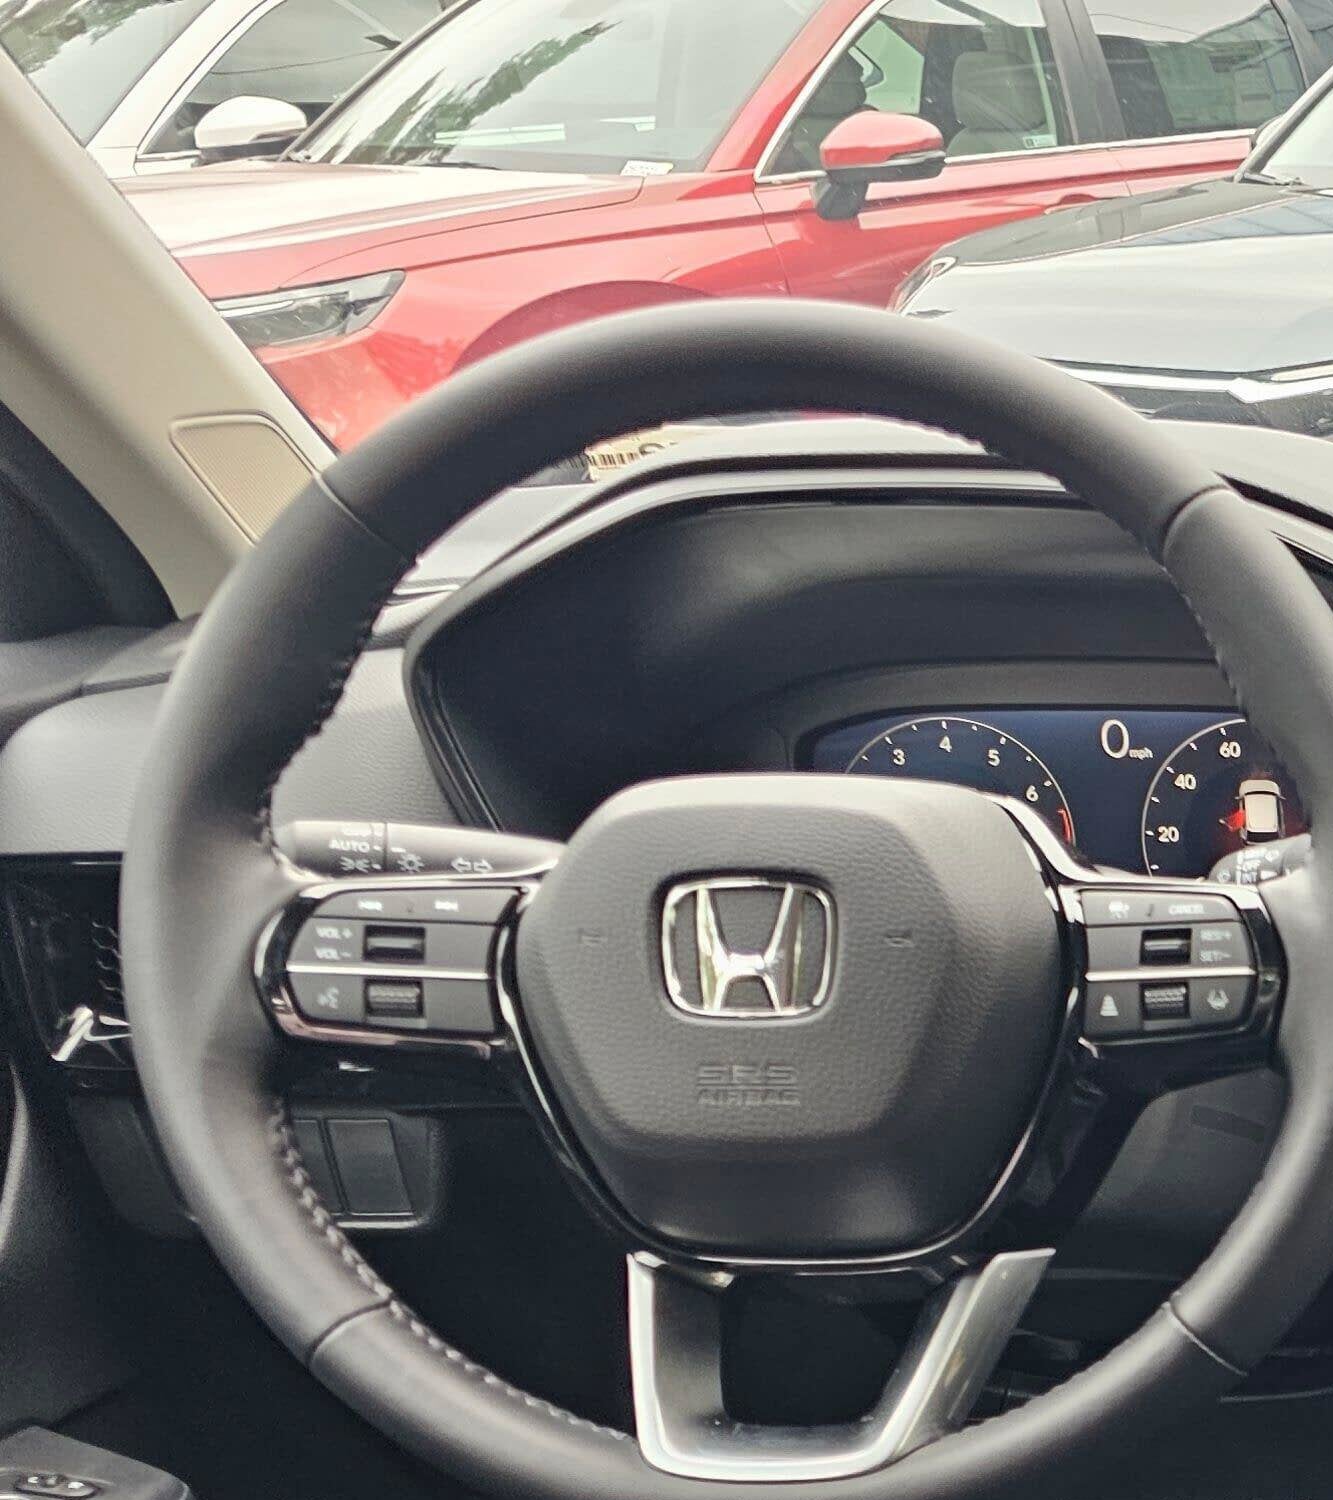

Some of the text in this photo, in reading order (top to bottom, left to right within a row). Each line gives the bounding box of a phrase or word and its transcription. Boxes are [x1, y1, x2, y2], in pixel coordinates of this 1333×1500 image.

[938, 735, 952, 753] 4
[1101, 719, 1130, 759] 0
[892, 748, 906, 766] 3
[987, 749, 1001, 767] 5
[1218, 741, 1242, 758] 60
[1174, 773, 1197, 790] 40
[1025, 785, 1039, 802] 6
[1157, 825, 1180, 843] 20
[329, 839, 370, 853] AUTO
